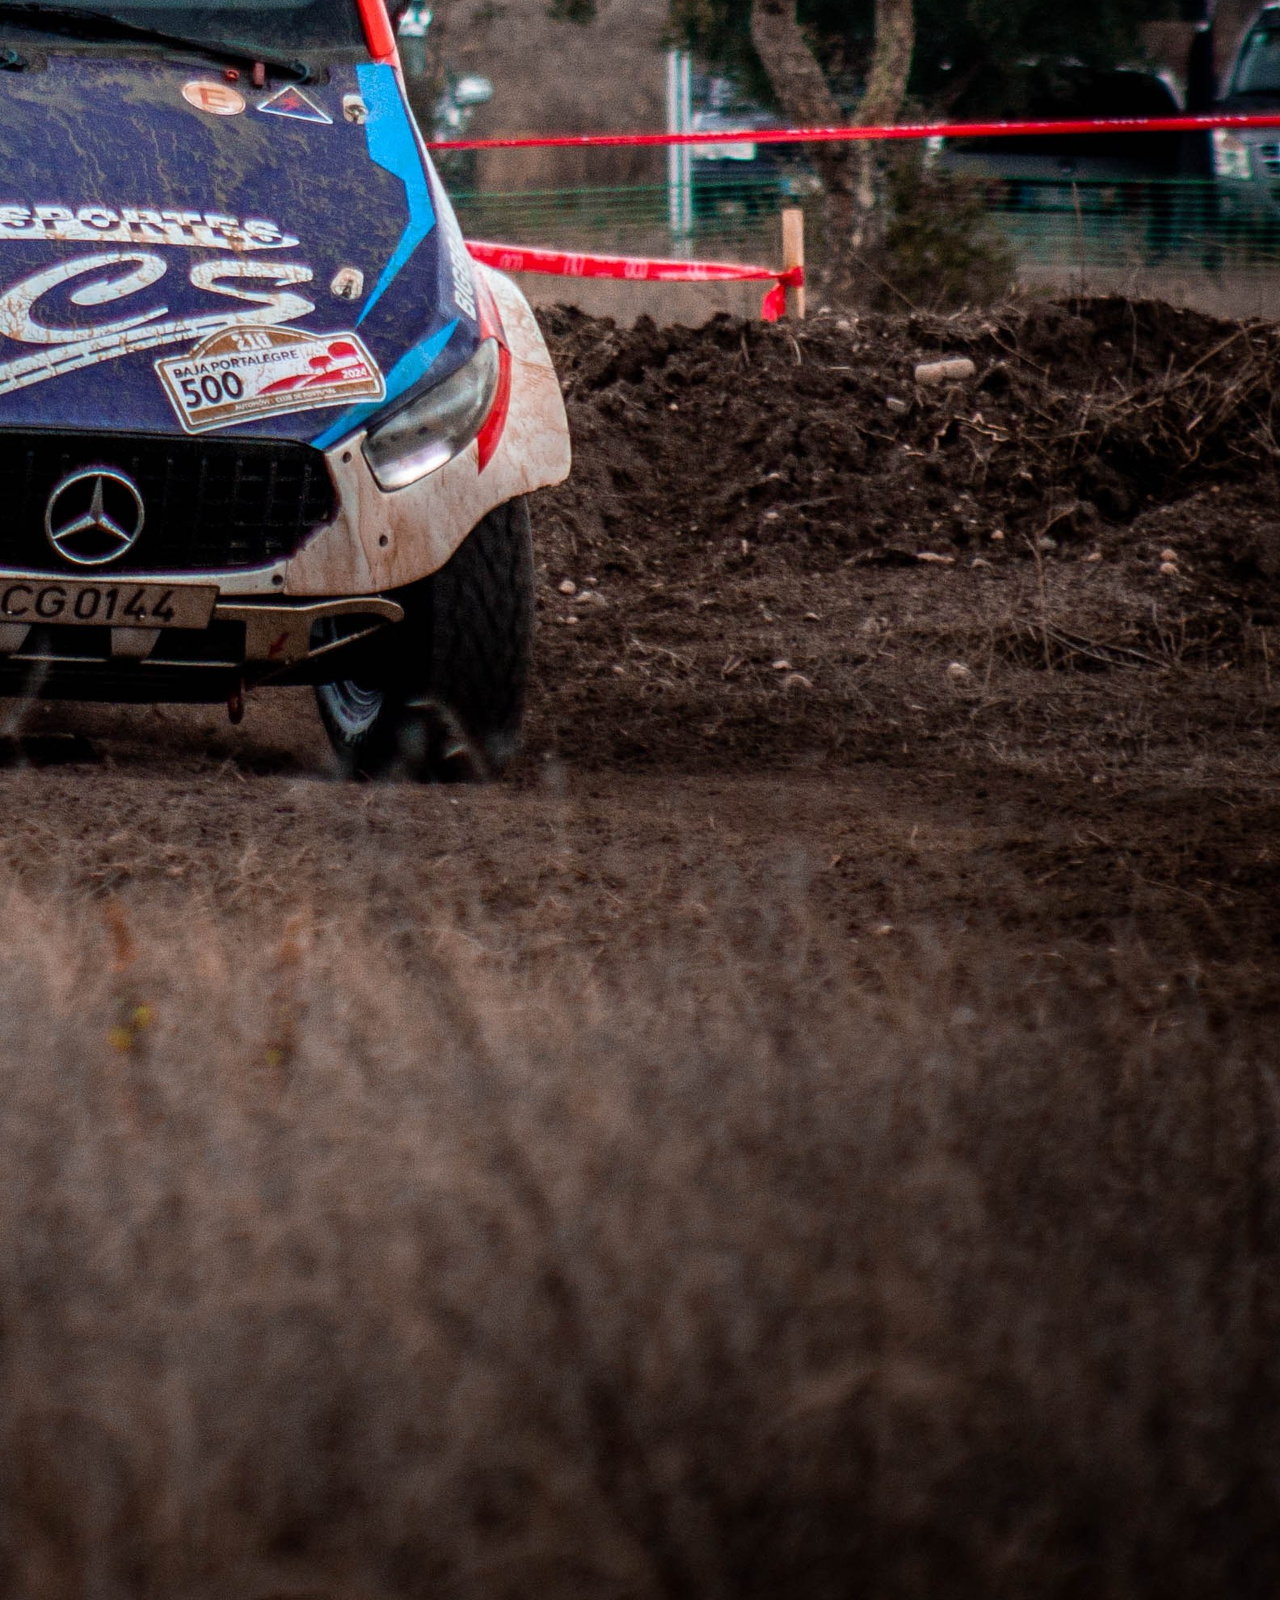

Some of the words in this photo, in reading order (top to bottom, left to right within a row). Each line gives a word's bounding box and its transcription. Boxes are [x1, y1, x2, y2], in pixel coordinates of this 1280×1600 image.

[232, 332, 273, 351] 210
[173, 365, 212, 379] BAJA
[211, 349, 300, 371] PORTALEGRE
[341, 366, 368, 380] 2024
[179, 371, 244, 408] 500
[0, 584, 176, 622] CG0144
